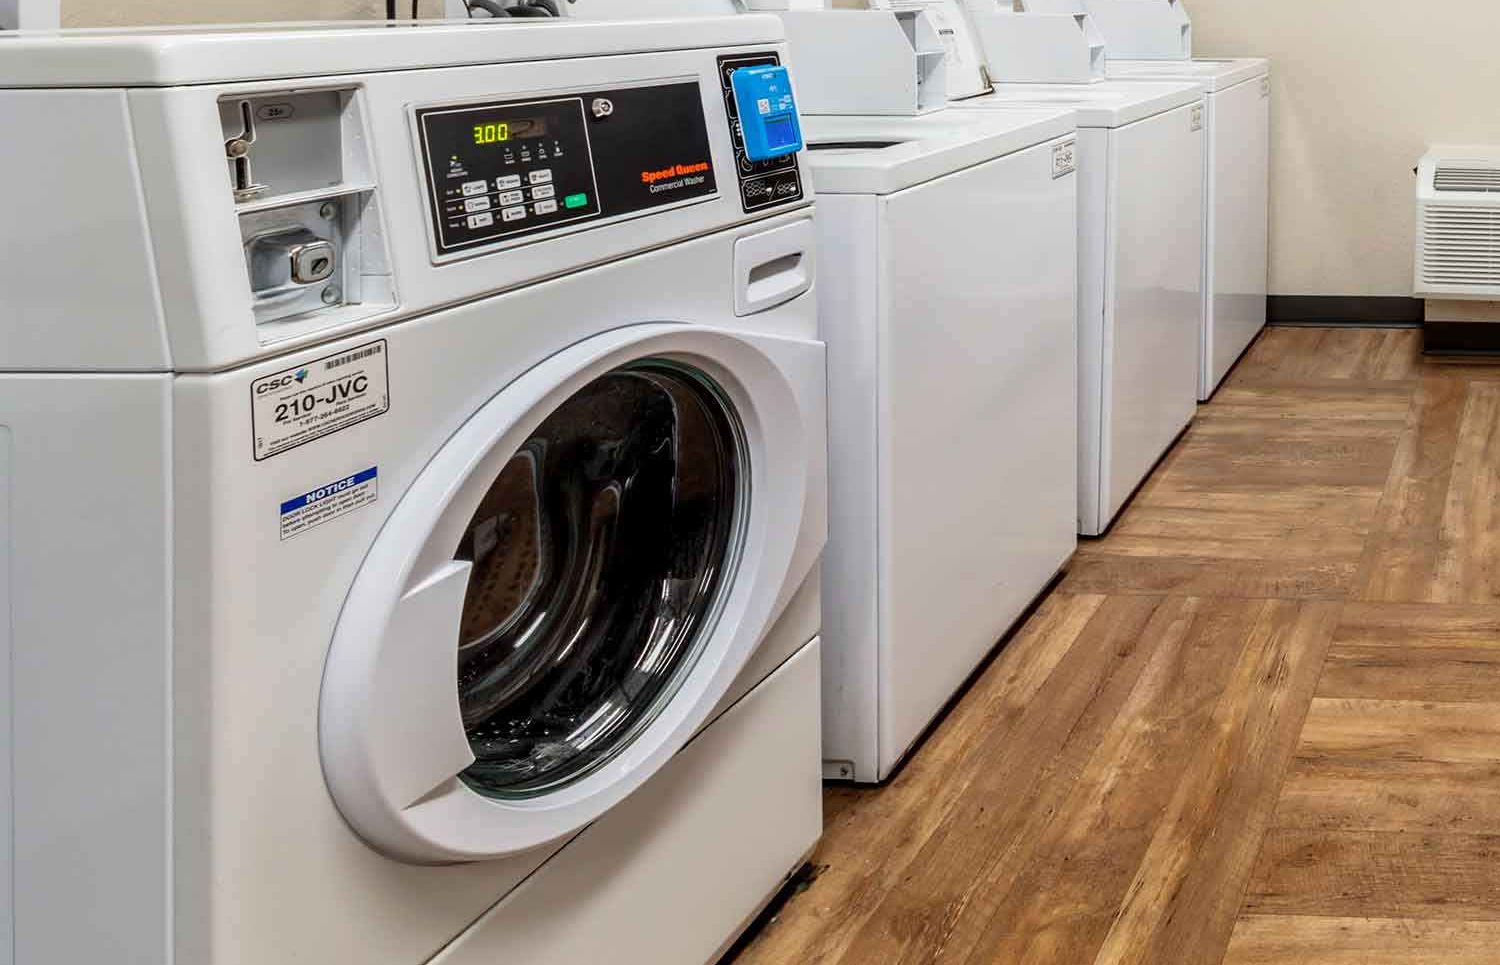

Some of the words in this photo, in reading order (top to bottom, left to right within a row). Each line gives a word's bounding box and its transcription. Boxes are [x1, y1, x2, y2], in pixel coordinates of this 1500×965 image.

[641, 166, 676, 184] Speed
[676, 162, 709, 175] Queen
[649, 179, 684, 194] Commercial
[684, 175, 705, 186] Washer
[256, 375, 293, 394] CSC
[275, 376, 368, 423] 210-JVC
[306, 476, 356, 504] NOTICE
